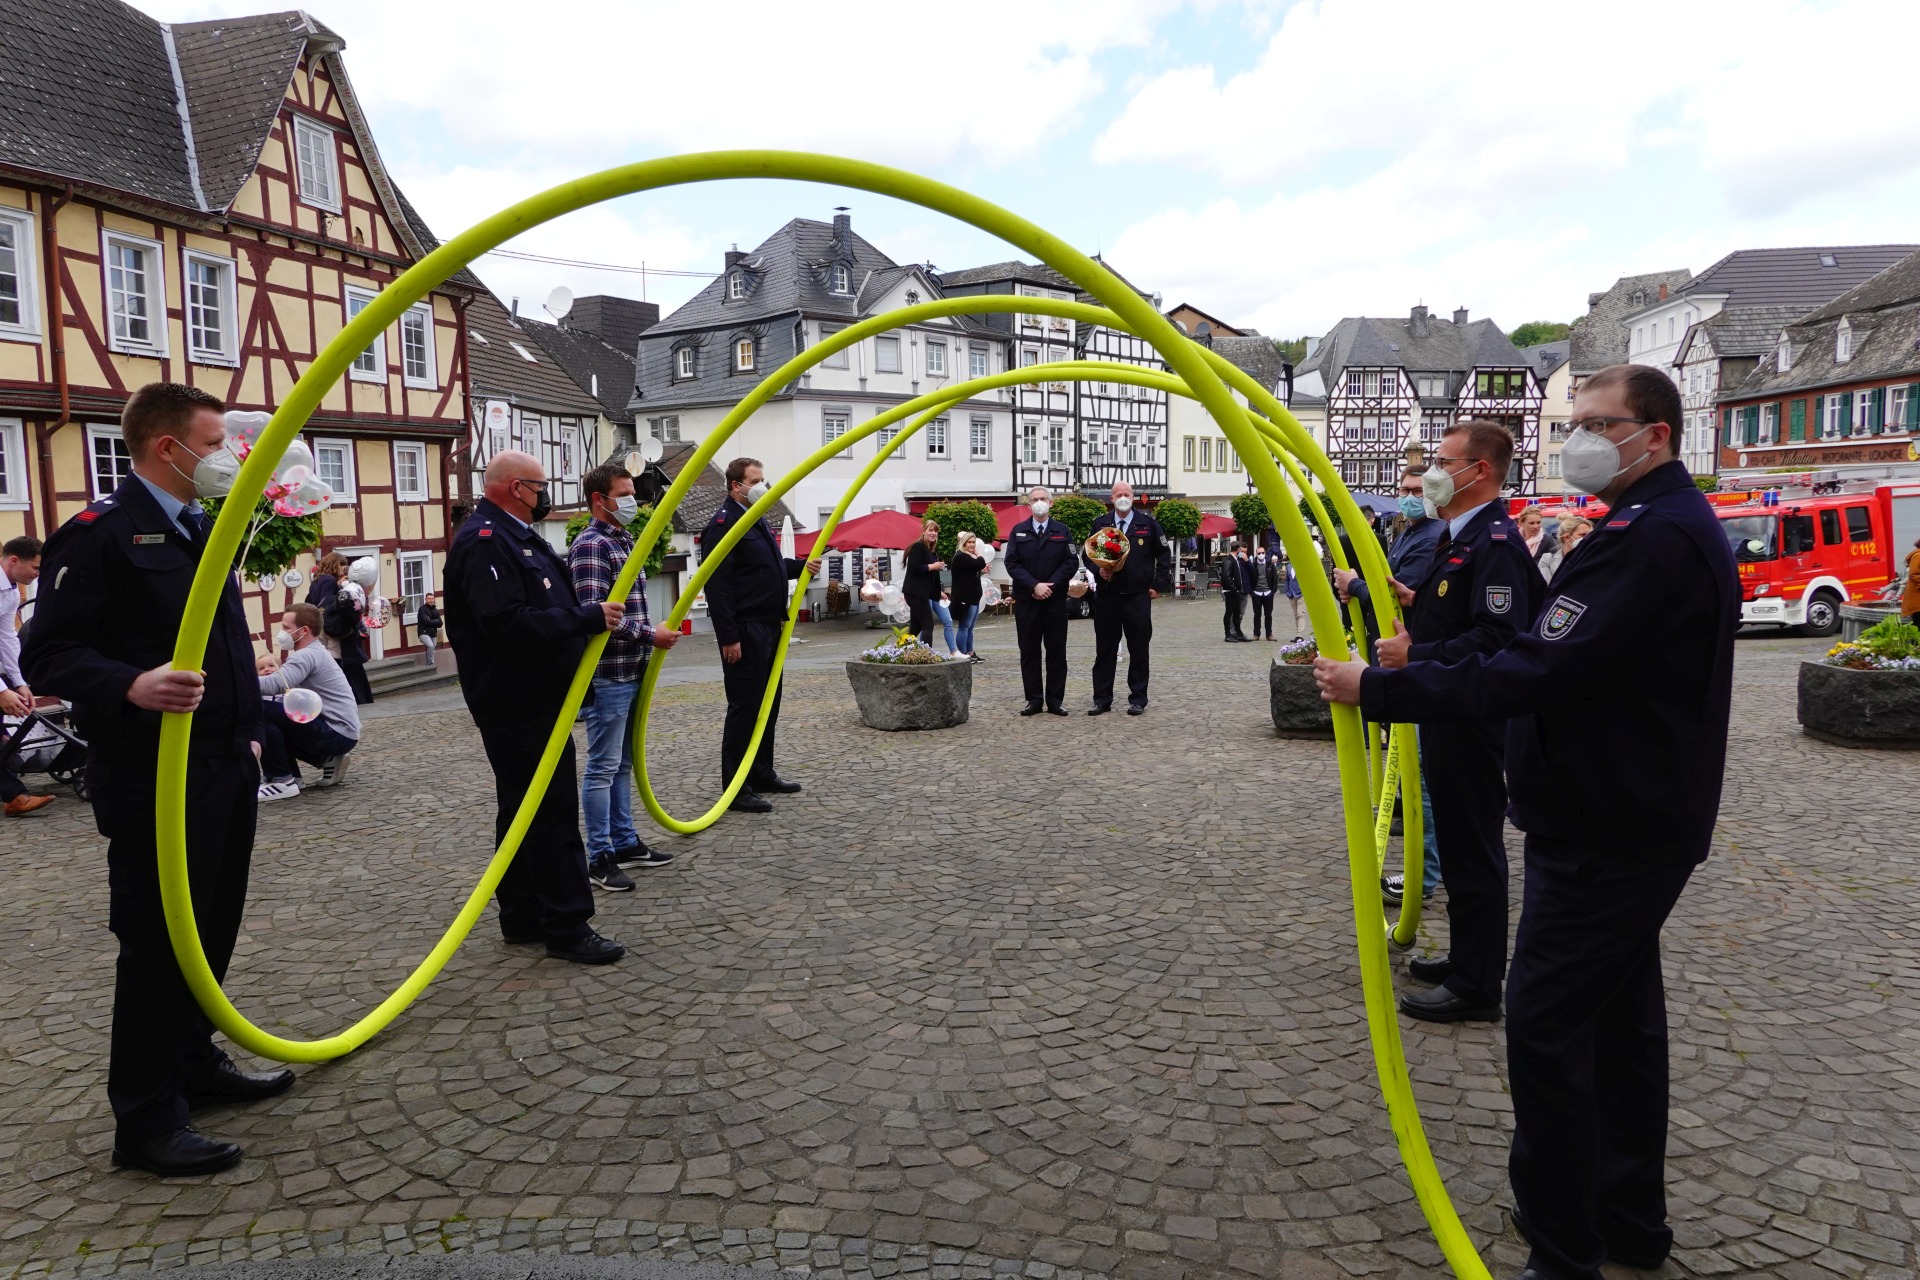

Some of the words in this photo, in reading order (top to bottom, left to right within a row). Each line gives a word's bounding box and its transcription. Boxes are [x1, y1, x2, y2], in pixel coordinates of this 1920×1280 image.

[1780, 450, 1816, 466] Valentino
[1868, 448, 1903, 461] LOUNGE
[1717, 493, 1748, 501] FEUERWEHR
[1860, 542, 1877, 555] 112
[1556, 599, 1583, 614] FEUERWEHR
[1566, 614, 1578, 626] Linz
[1377, 822, 1389, 840] DIN
